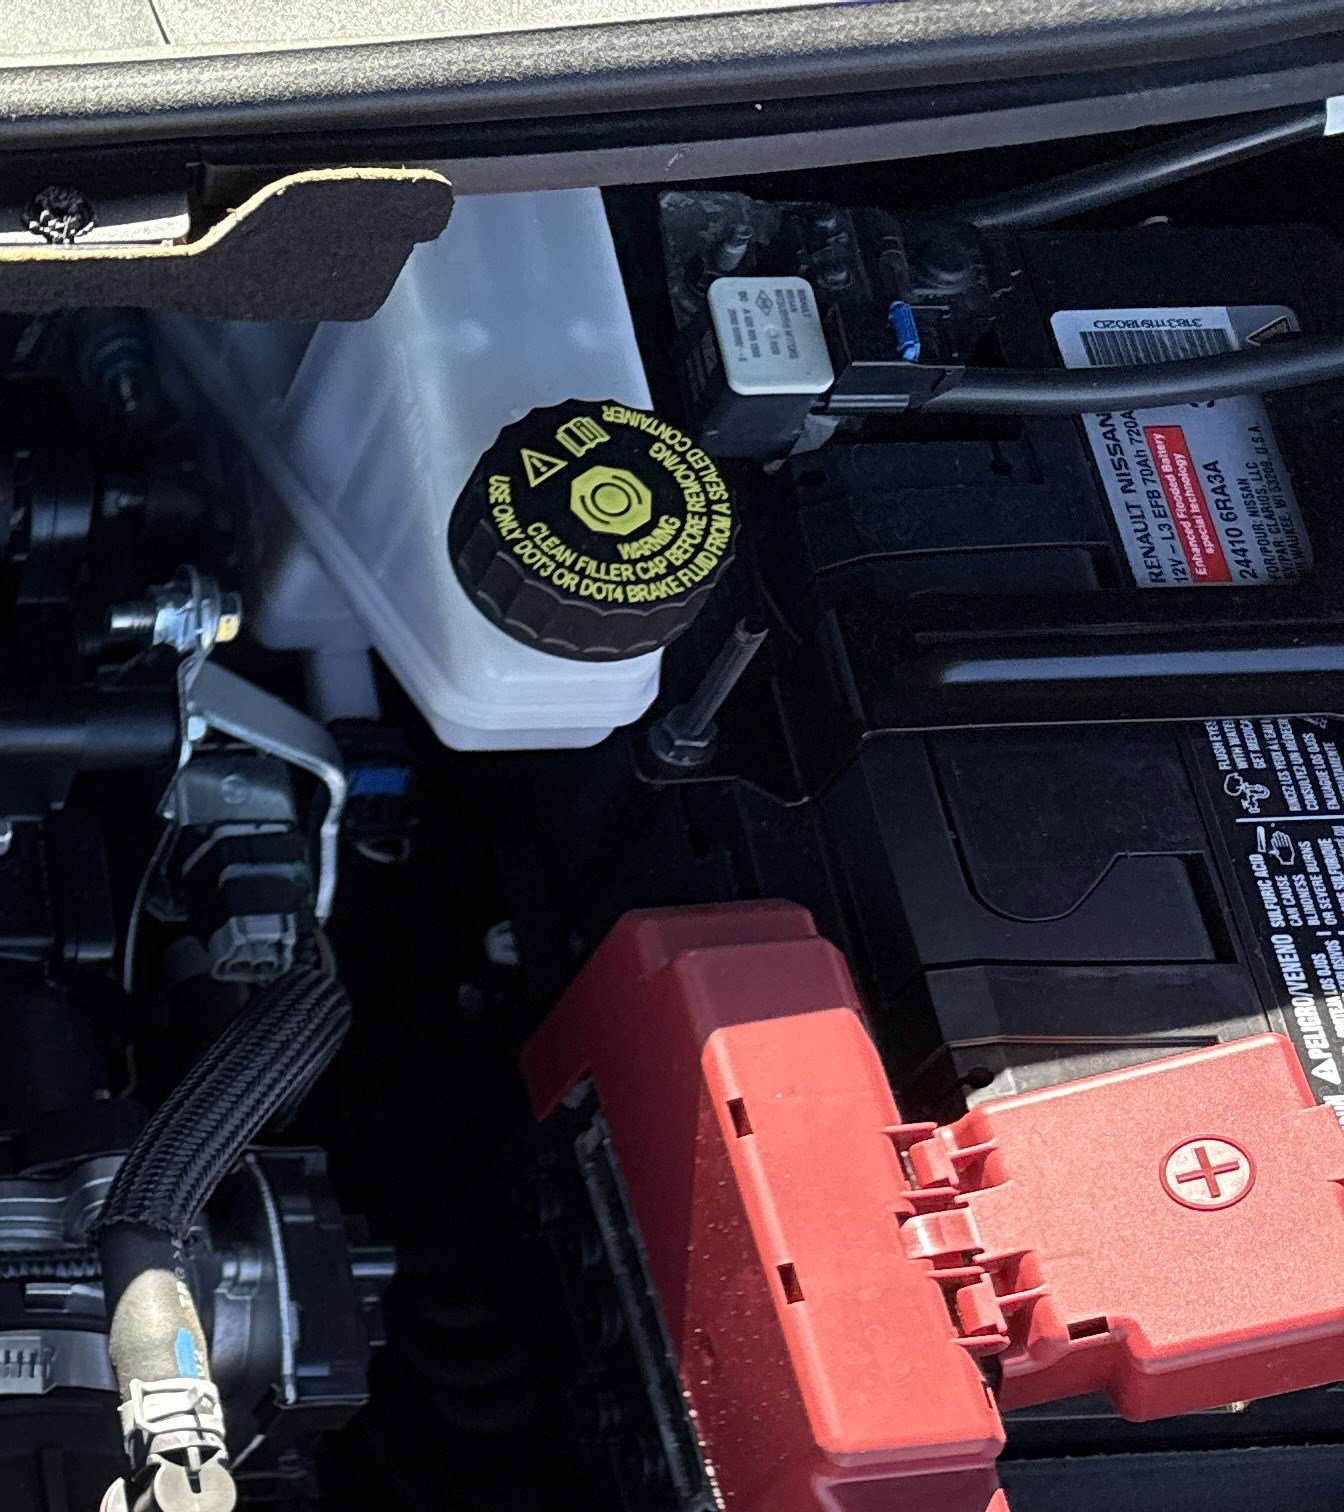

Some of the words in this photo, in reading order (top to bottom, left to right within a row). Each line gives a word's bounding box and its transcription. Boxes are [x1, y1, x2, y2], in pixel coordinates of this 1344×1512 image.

[1120, 410, 1144, 446] 720A
[1096, 412, 1137, 494] NISSAN
[1133, 449, 1157, 486] 70Ah
[1152, 432, 1173, 473] Battery
[488, 474, 512, 504] USE
[648, 441, 708, 513] REMOVING
[685, 448, 729, 501] SEALED
[1172, 451, 1201, 515] technology
[1201, 459, 1239, 523] 6RA3A
[1245, 461, 1263, 485] LLC
[711, 502, 732, 515] A
[1145, 489, 1169, 519] EFB
[1163, 473, 1189, 521] Flooded
[1237, 477, 1259, 518] NISSAN
[492, 504, 526, 542] ONLY
[616, 514, 681, 560] WARNING
[664, 512, 708, 567] BEFORE
[703, 514, 732, 556] FROM
[1124, 500, 1165, 583] RENAULT
[1157, 522, 1176, 540] L3
[1193, 514, 1215, 555] special
[512, 539, 557, 578] DOT3
[526, 521, 578, 567] CLEAN
[1179, 520, 1208, 576] Enhanced
[1224, 526, 1259, 580] 24410
[551, 567, 580, 593] OR
[574, 555, 636, 582] FILLER
[635, 554, 669, 580] CAP
[677, 550, 719, 588] FLUID
[1169, 557, 1188, 583] 12V
[579, 577, 624, 604] DOT4
[626, 574, 686, 604] BRAKE
[1211, 741, 1233, 770] FLUSH
[1230, 746, 1249, 770] WITH
[1250, 751, 1267, 769] GET
[1308, 753, 1327, 769] LOS
[1276, 770, 1293, 785] LES
[1291, 765, 1320, 811] CONSULTEZ
[1248, 853, 1270, 878] ACID
[1297, 840, 1321, 873] BURNS
[1257, 879, 1286, 928] SULFURIC
[1274, 874, 1296, 906] CAUSE
[1291, 873, 1321, 926] BLINDNESS
[1308, 873, 1333, 910] SEVERE
[1286, 907, 1304, 927] CAN
[1321, 910, 1338, 926] OR
[1311, 952, 1333, 977] OJOS
[1270, 934, 1333, 1060] PELIGRO/VENENO
[1318, 977, 1338, 996] LOS
